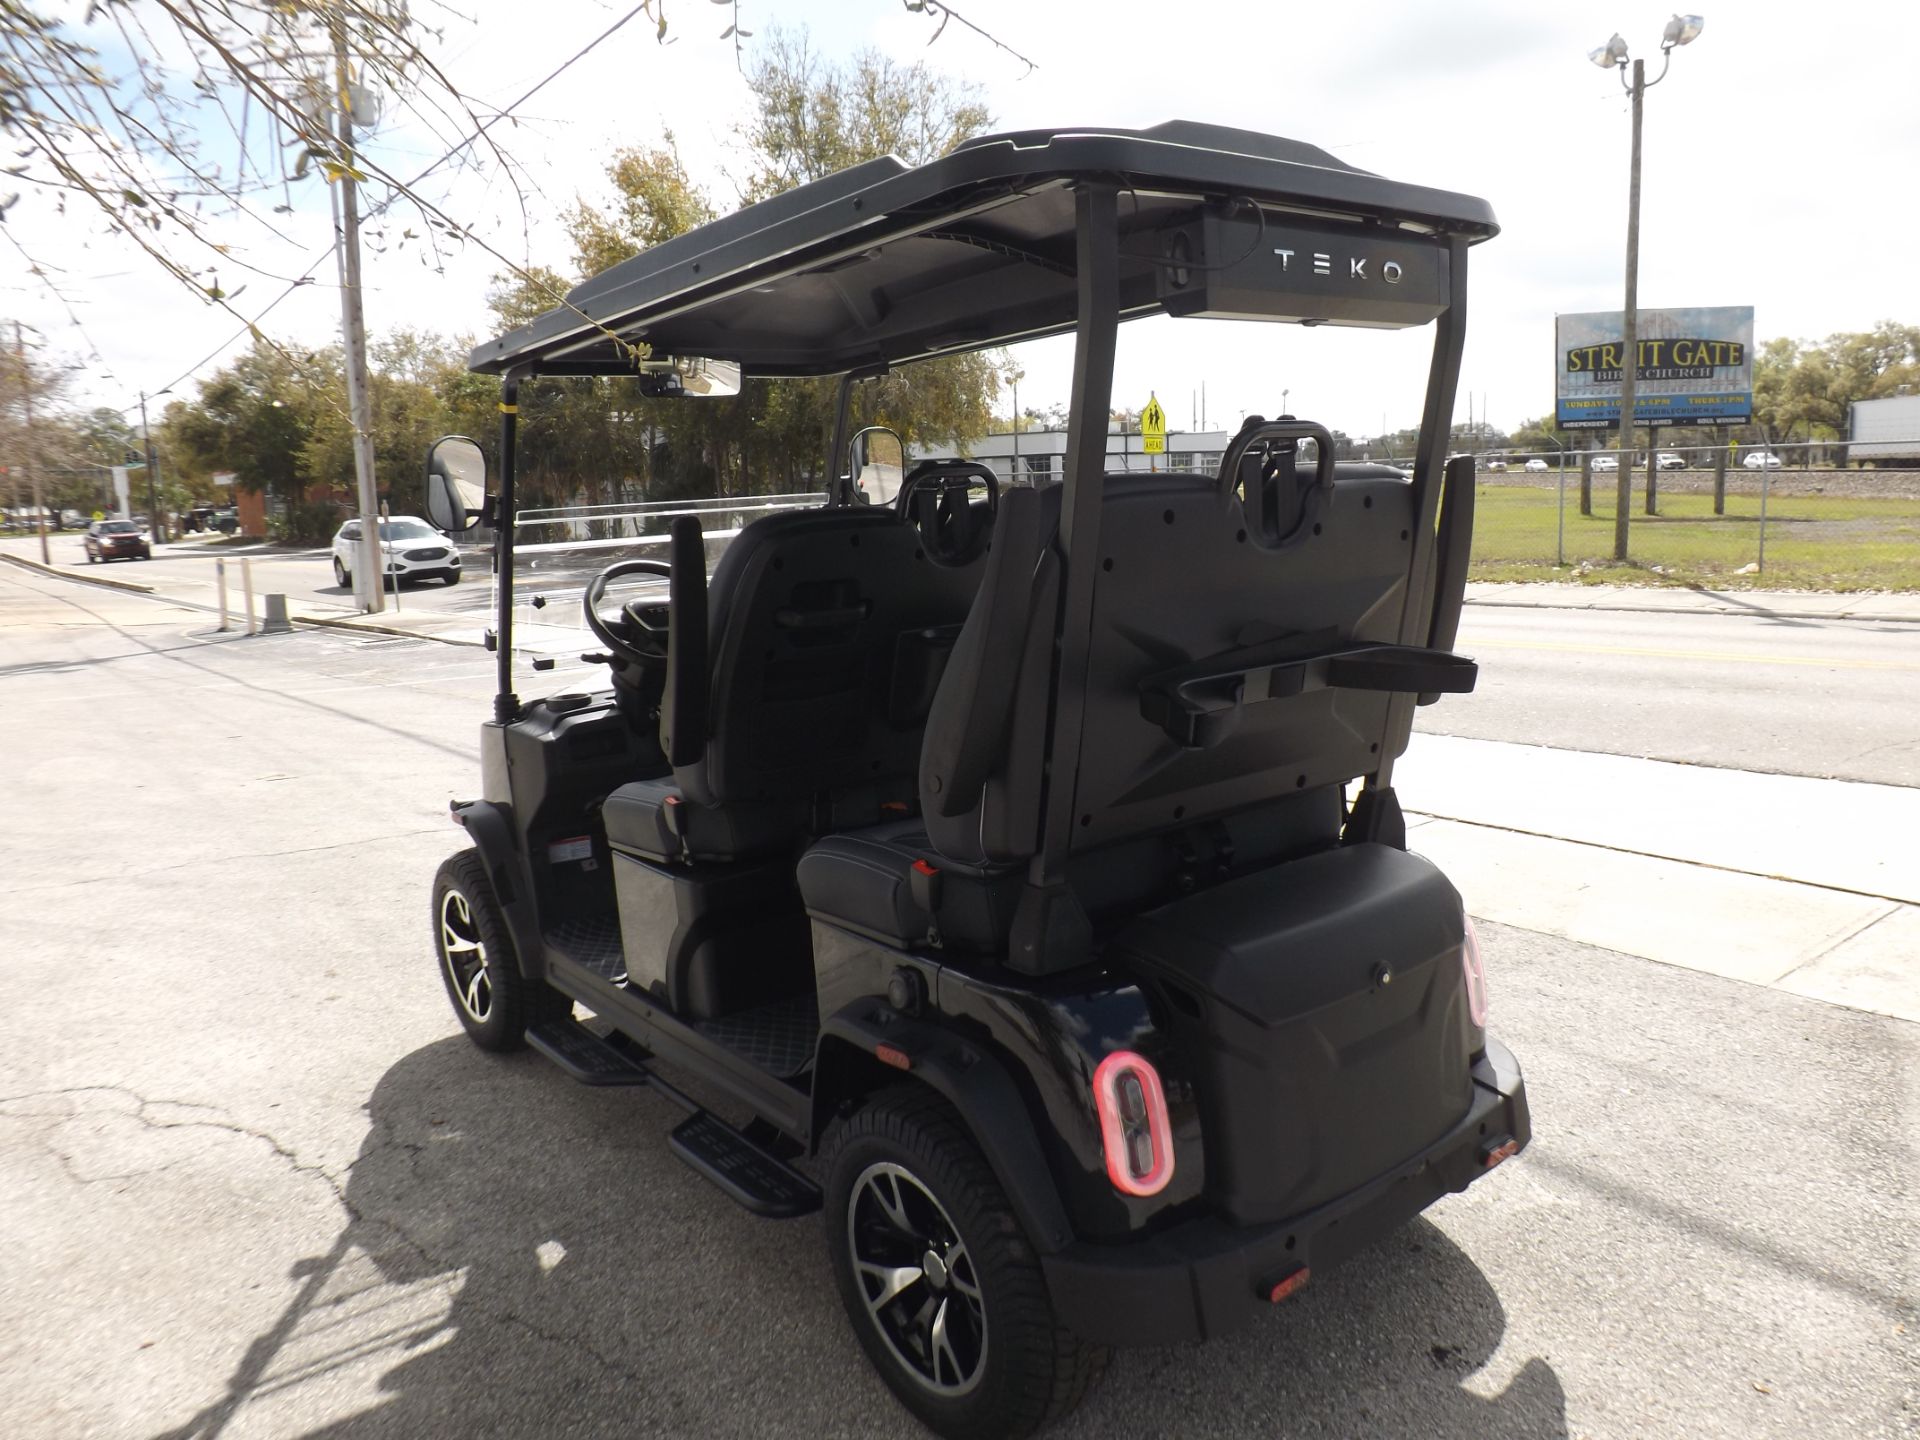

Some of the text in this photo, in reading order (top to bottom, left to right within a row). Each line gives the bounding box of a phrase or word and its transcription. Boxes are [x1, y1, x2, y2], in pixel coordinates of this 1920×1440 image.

[1273, 248, 1402, 284] TEKO
[1569, 341, 1742, 371] STRIT GATE
[1597, 367, 1711, 381] BIBE CHURCH
[1565, 400, 1608, 409] SUNDAYS
[1563, 420, 1609, 428] INDEPENDENT
